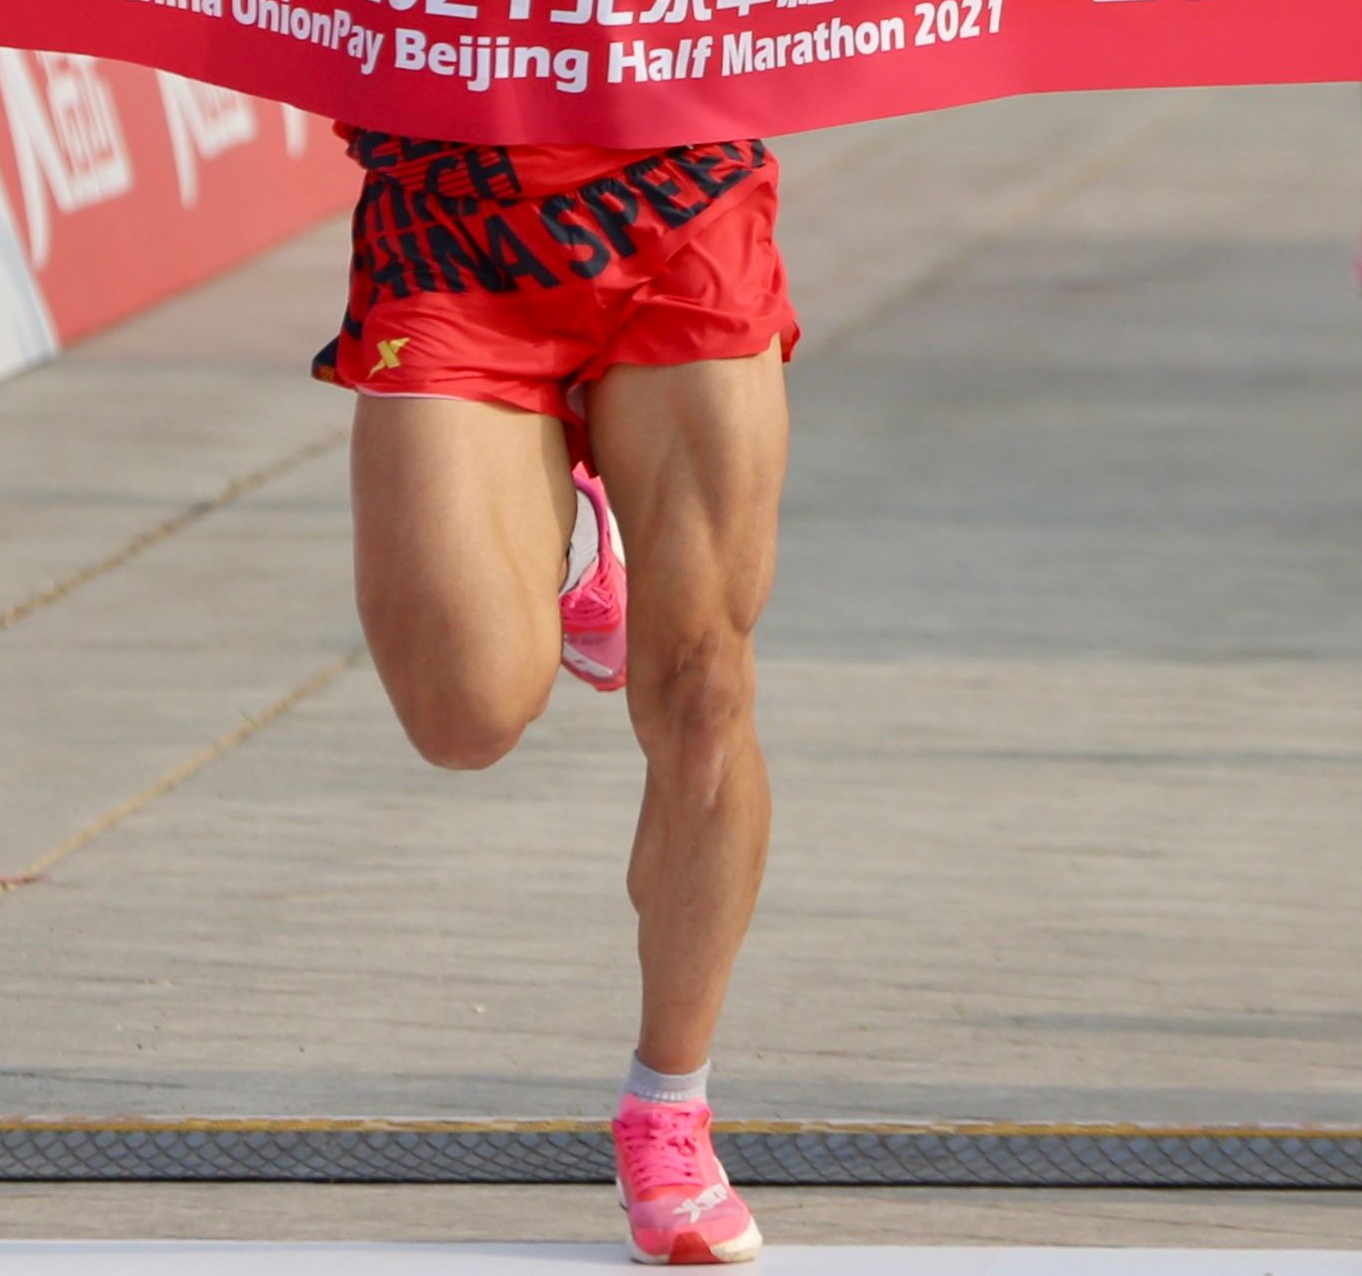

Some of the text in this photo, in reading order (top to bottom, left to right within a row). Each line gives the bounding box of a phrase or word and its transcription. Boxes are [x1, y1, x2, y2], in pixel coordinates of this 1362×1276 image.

[393, 26, 590, 92] Beijing
[609, 37, 714, 84] Half
[719, 17, 905, 78] Marathon
